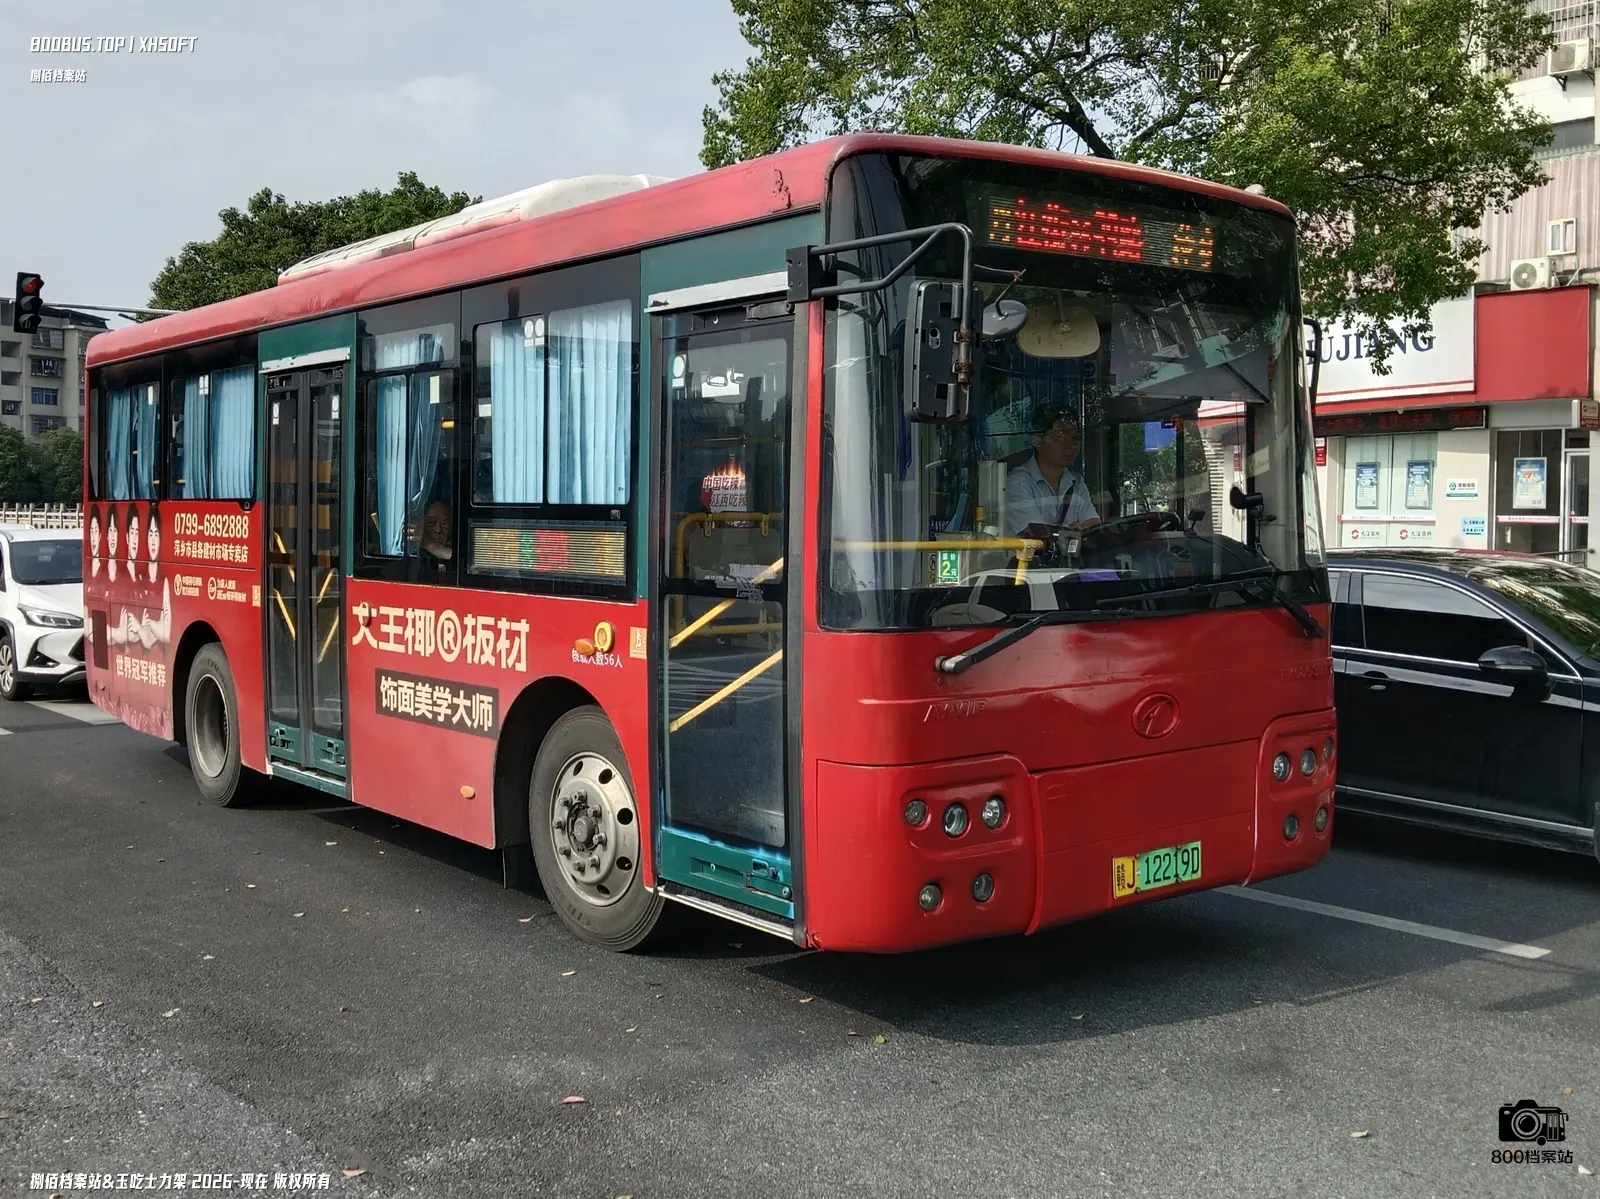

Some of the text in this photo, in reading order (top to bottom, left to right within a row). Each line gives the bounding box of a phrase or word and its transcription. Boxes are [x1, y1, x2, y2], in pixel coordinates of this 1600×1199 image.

[174, 512, 249, 539] 0799-6892888
[116, 654, 166, 688] 世界冠军推荐
[379, 675, 494, 733] 饰面美学大师
